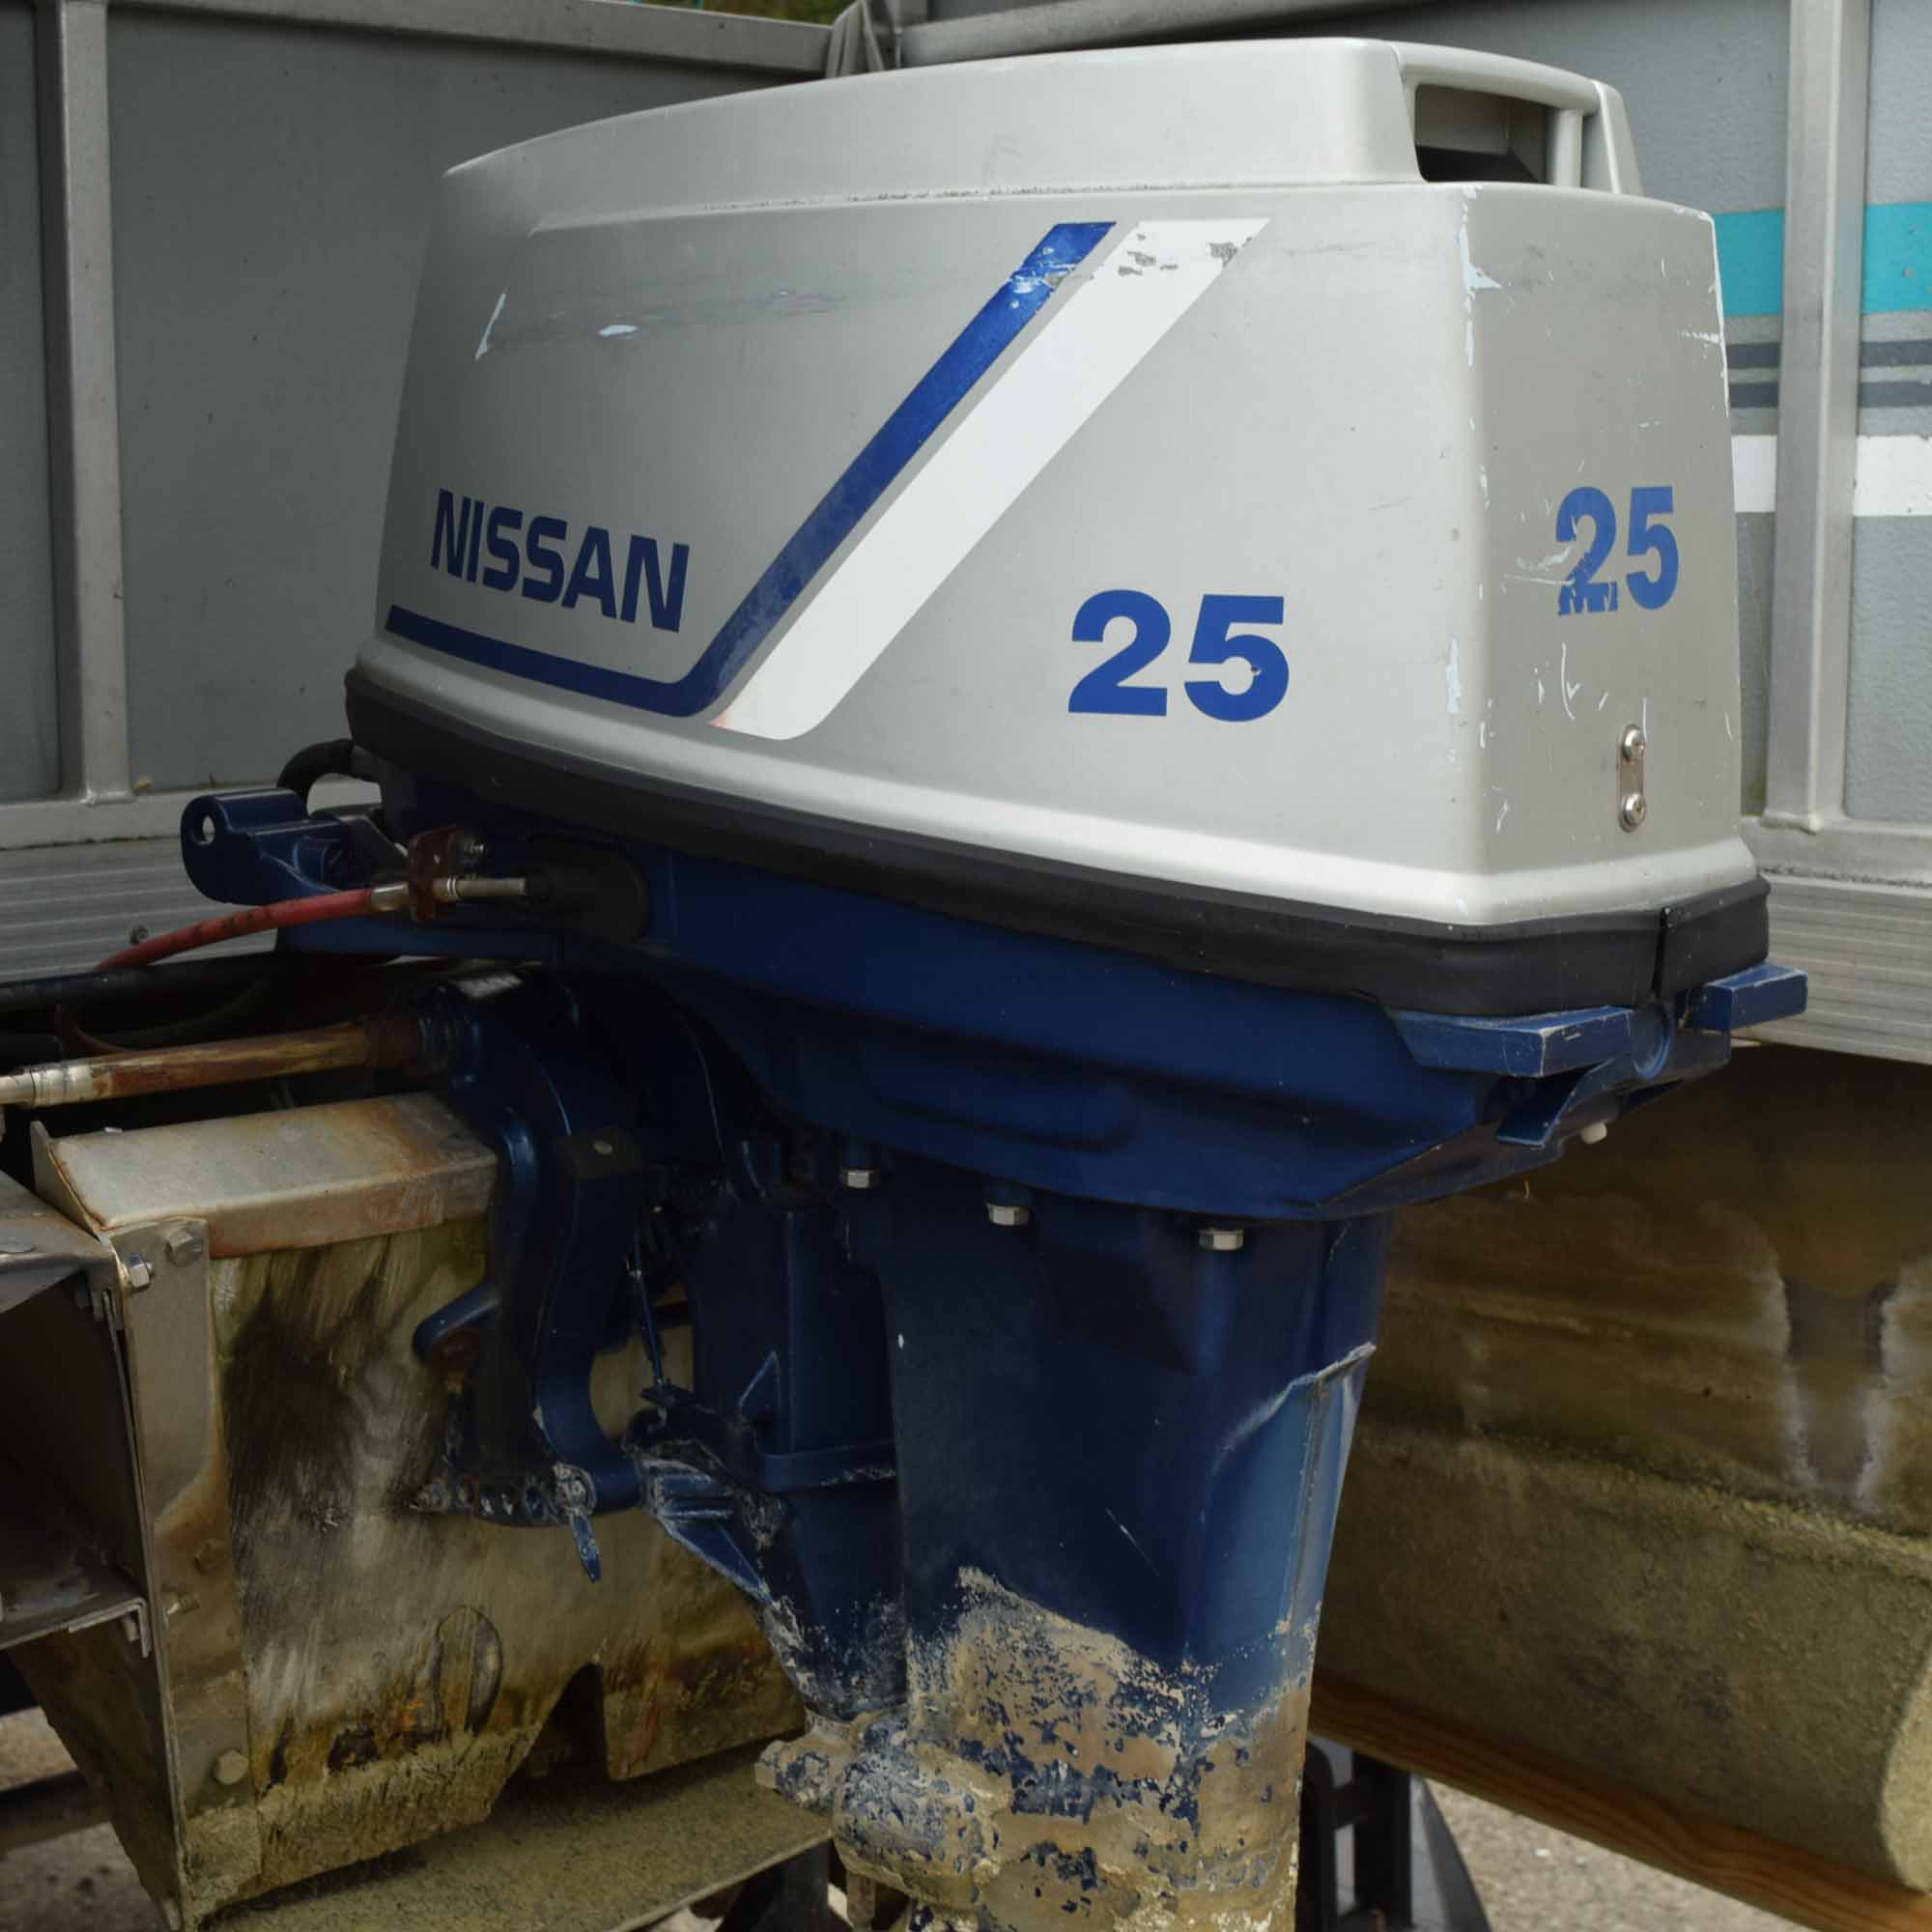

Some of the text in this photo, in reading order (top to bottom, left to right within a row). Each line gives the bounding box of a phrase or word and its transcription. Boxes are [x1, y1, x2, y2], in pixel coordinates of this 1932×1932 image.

[431, 488, 690, 633] NISSAN
[1556, 486, 1679, 615] 25
[1068, 589, 1290, 722] 25
